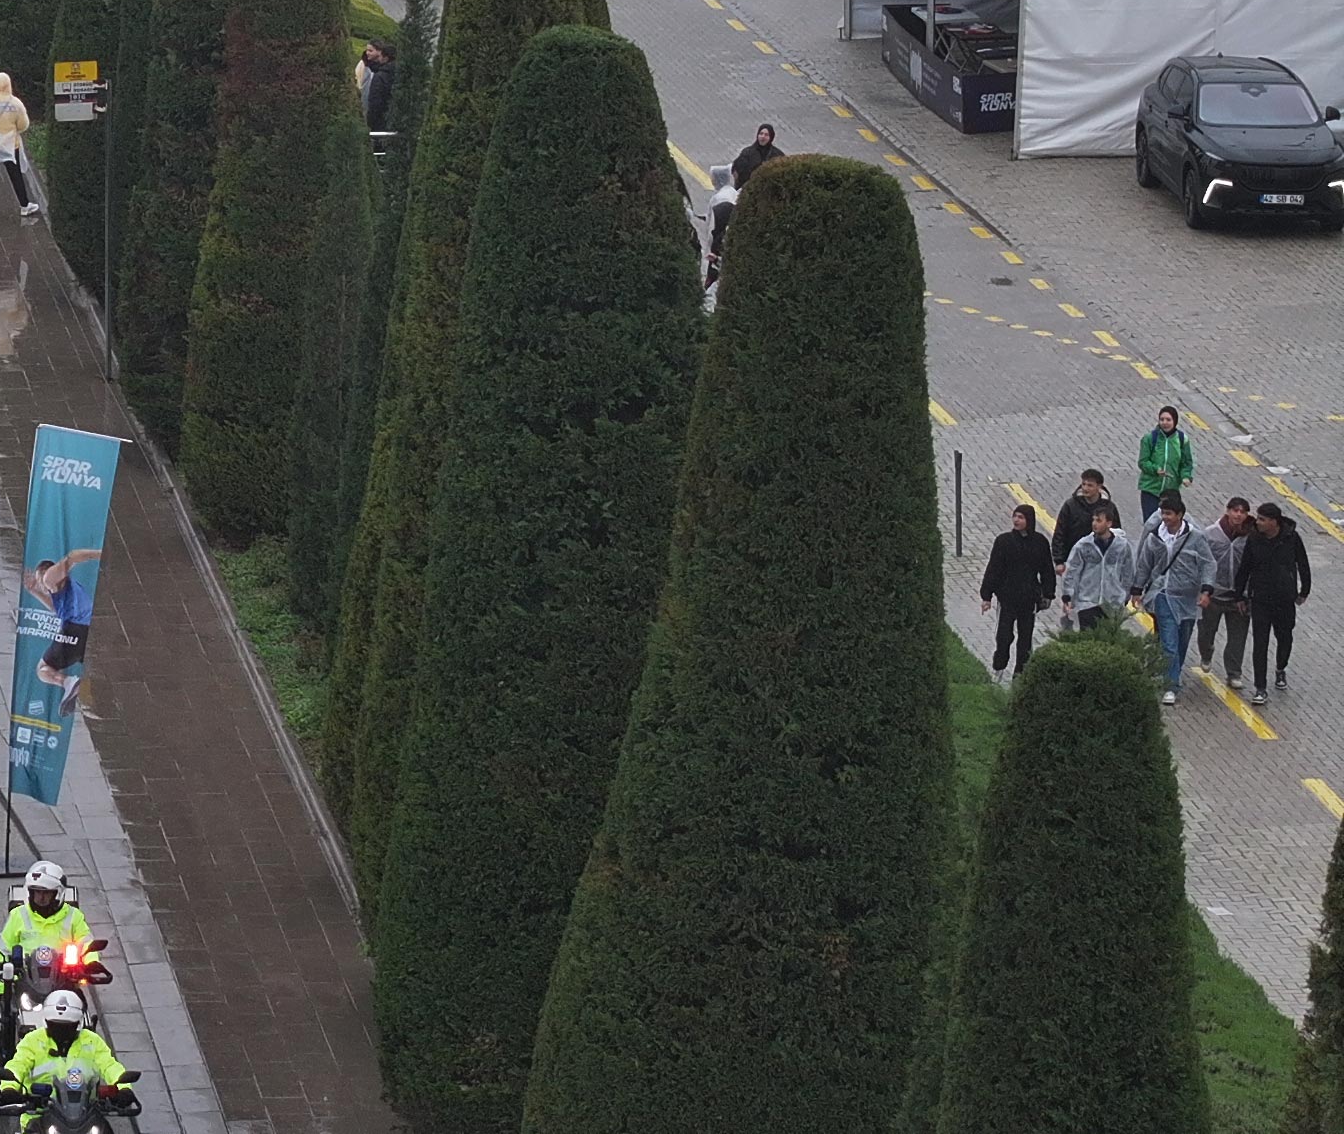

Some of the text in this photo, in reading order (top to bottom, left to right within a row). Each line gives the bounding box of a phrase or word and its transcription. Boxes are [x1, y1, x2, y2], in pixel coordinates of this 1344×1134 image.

[42, 455, 91, 475] SPOR
[41, 468, 101, 490] KONYA
[24, 612, 61, 624] KONYA
[16, 626, 79, 645] MARATONU
